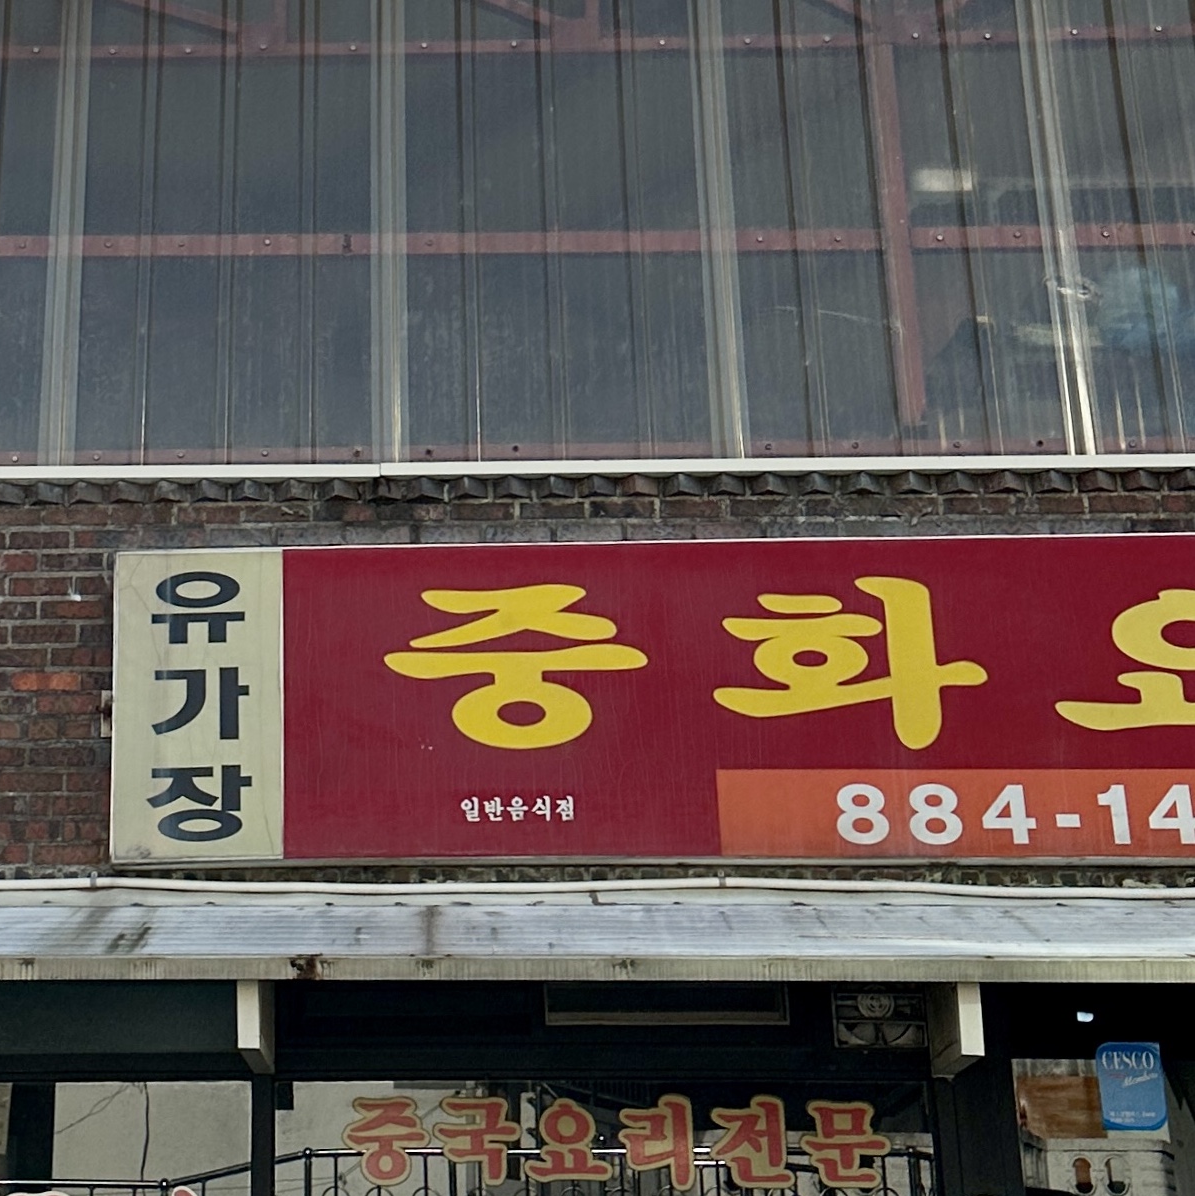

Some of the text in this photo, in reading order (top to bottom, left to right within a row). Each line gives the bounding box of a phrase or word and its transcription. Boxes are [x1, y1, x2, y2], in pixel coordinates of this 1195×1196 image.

[147, 571, 252, 842] 유가장
[460, 795, 574, 822] 일반음식점
[1101, 1051, 1154, 1070] CESCO
